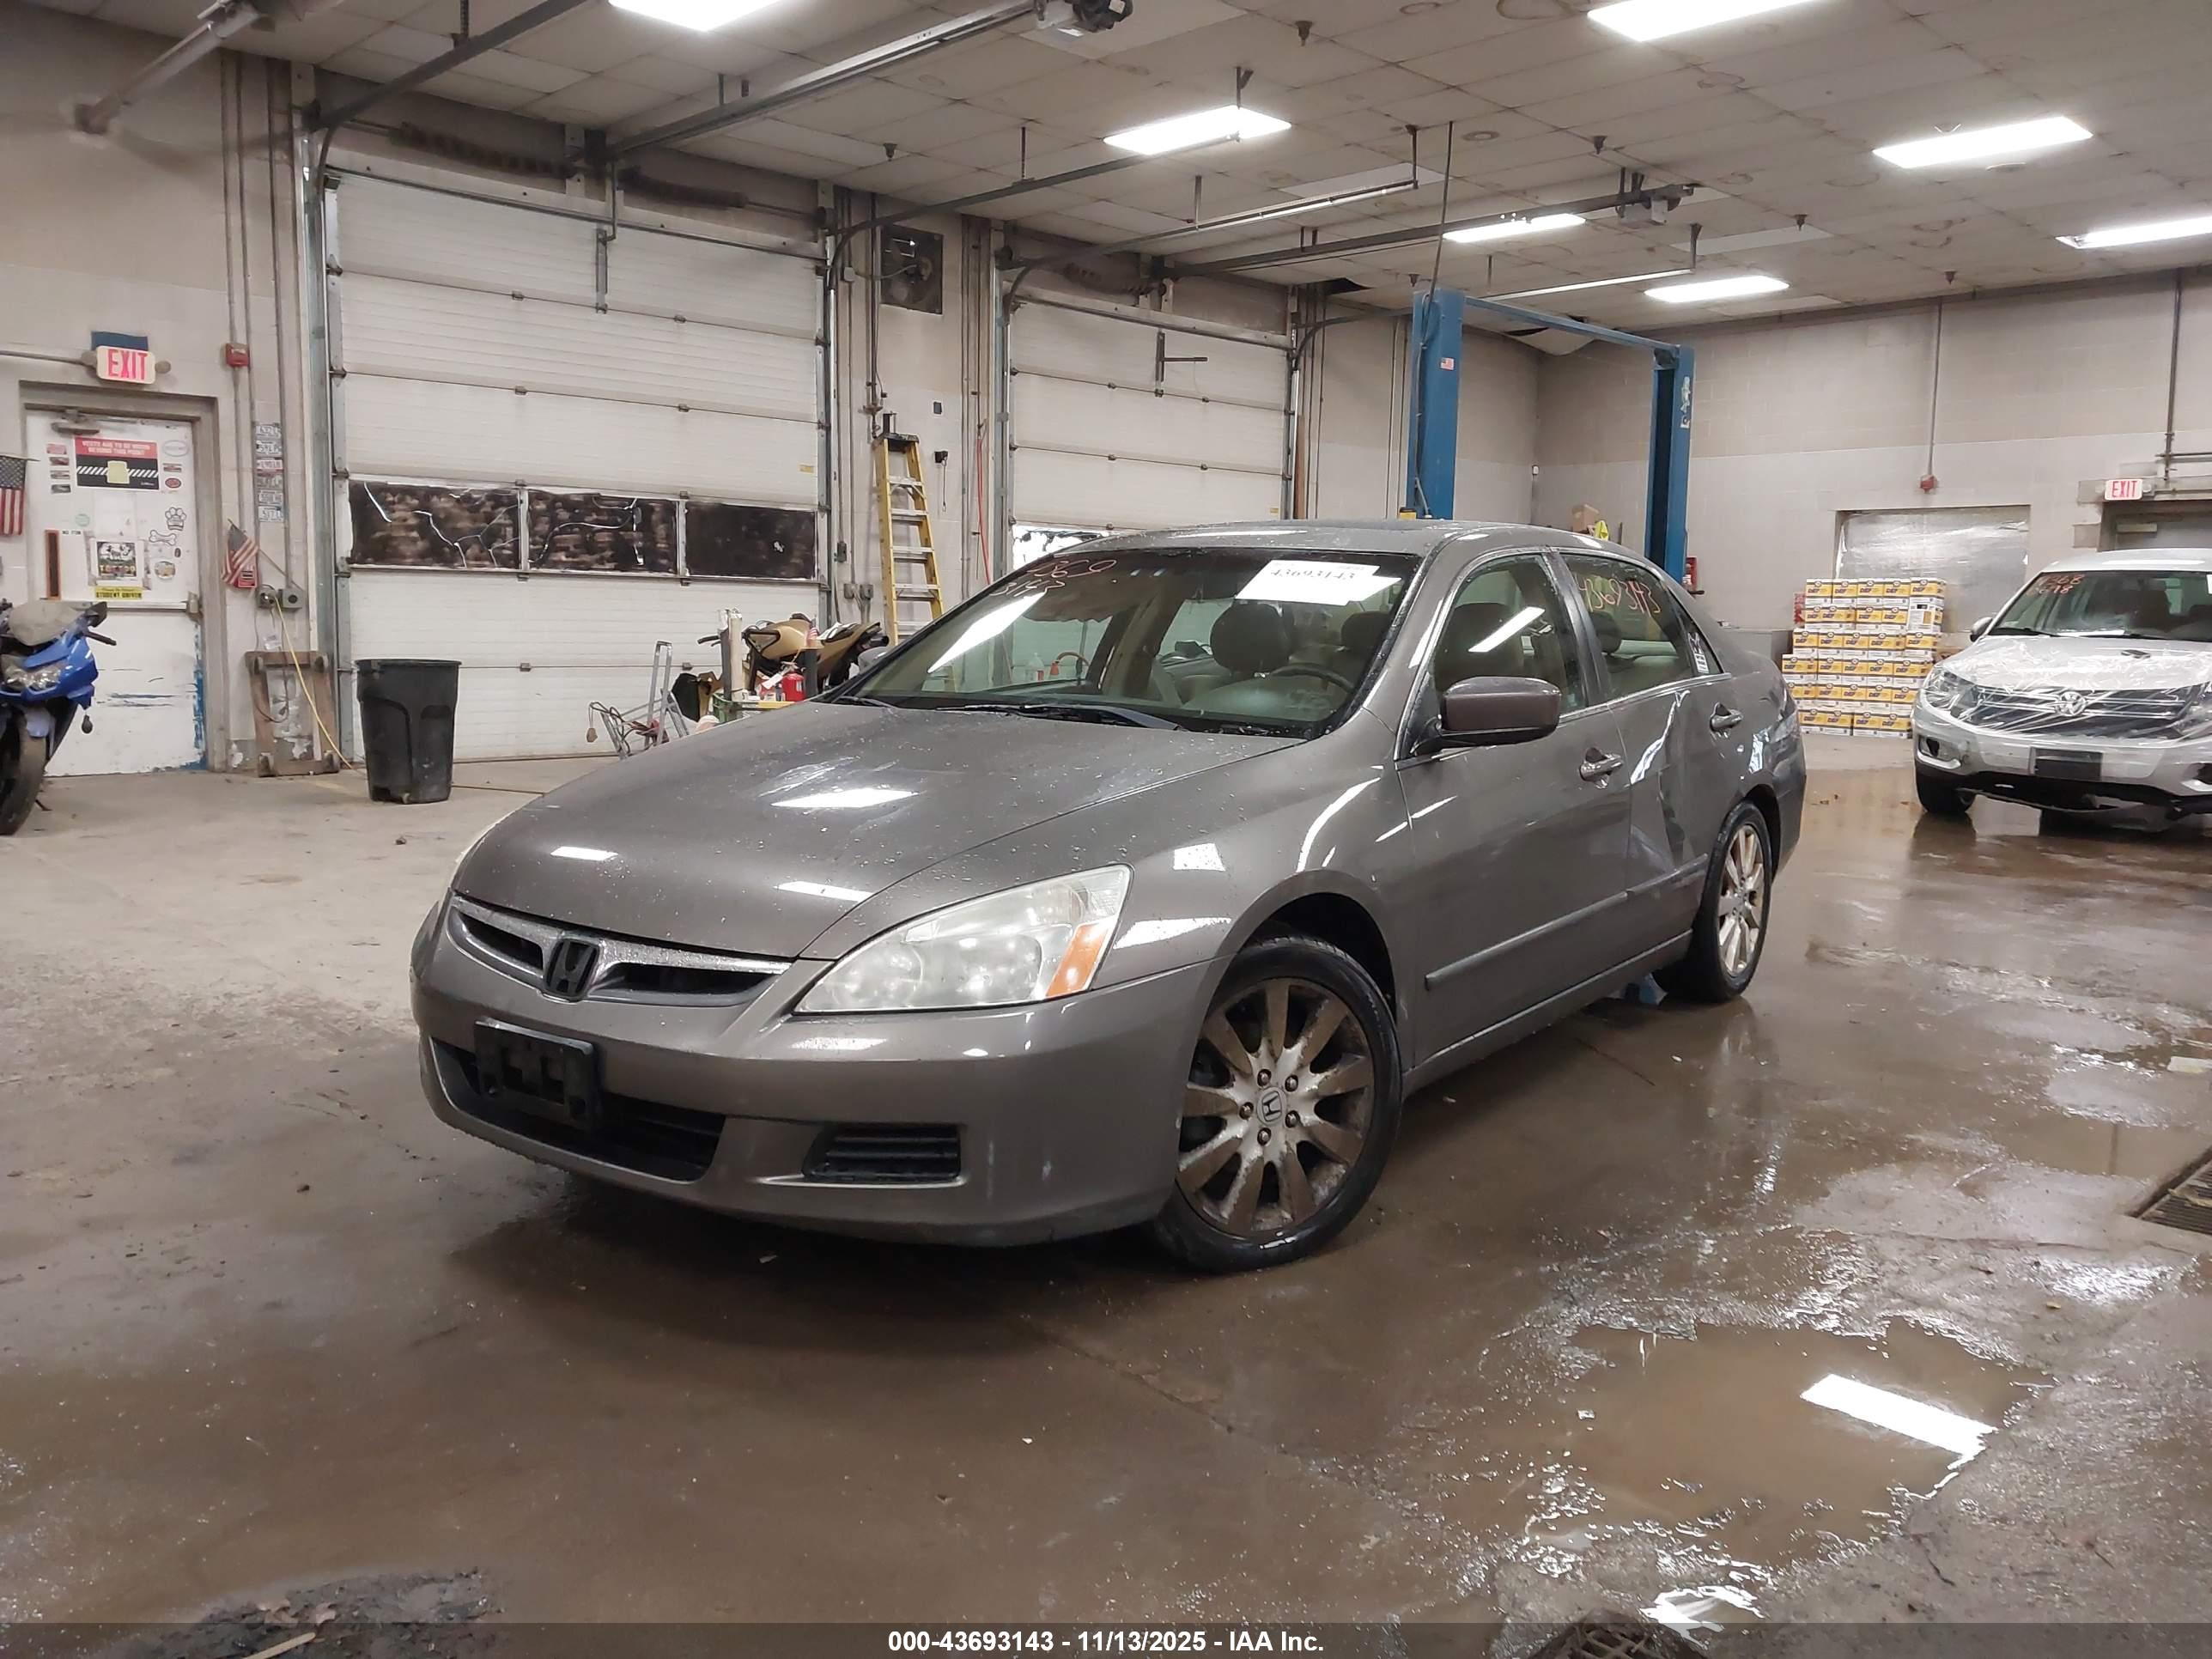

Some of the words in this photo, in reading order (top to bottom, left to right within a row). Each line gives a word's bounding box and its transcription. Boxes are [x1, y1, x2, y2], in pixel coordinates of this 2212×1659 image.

[108, 349, 148, 380] EXIT
[2112, 480, 2137, 498] EXIT
[1575, 573, 1661, 617] 43693143
